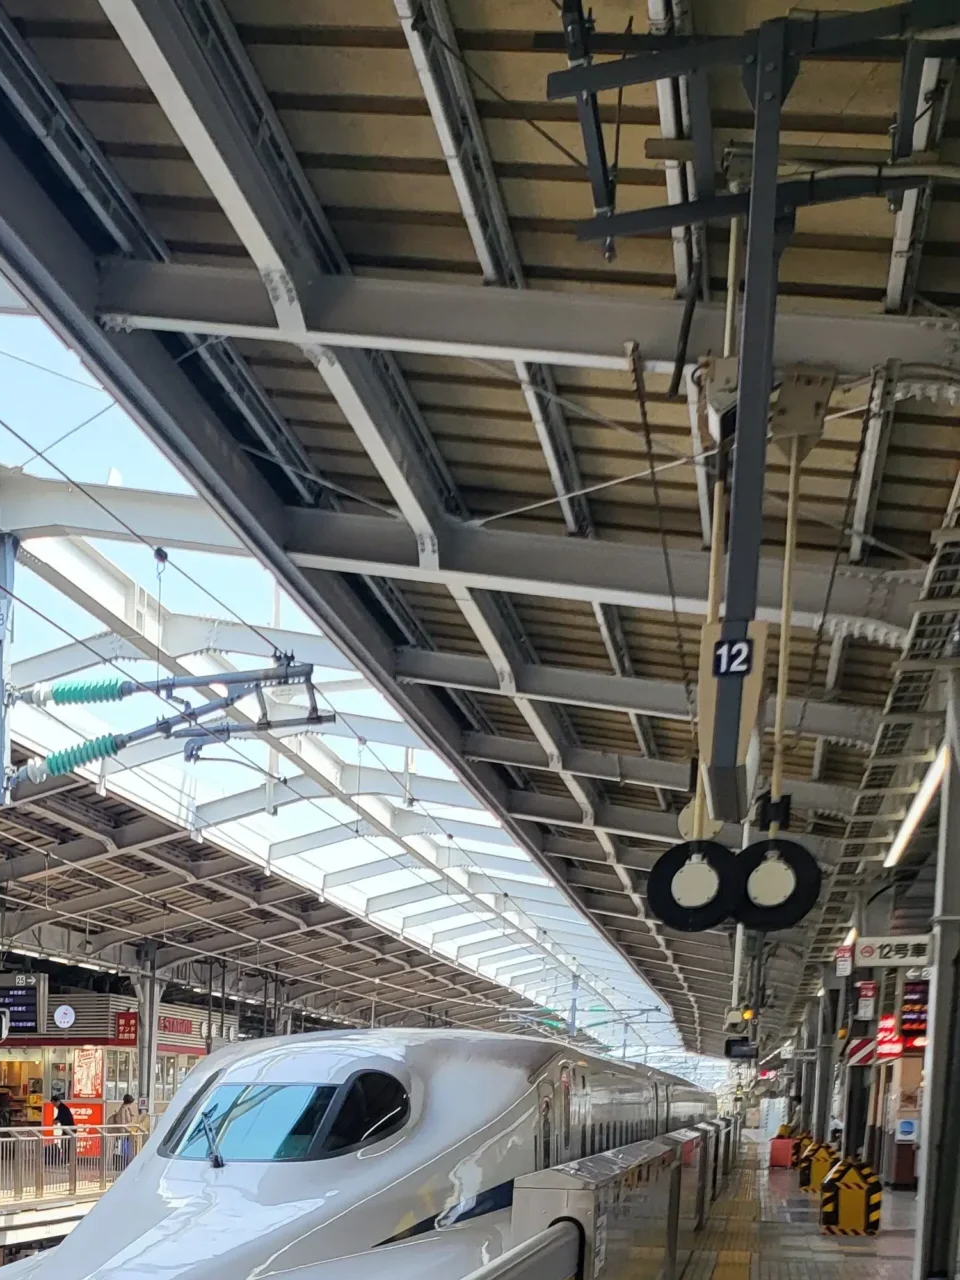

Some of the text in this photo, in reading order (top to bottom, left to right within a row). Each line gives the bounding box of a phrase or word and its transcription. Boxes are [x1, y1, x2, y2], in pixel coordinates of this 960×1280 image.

[716, 641, 749, 674] 12
[877, 943, 928, 959] 12号車
[16, 976, 25, 985] 25
[165, 1017, 192, 1034] STATION
